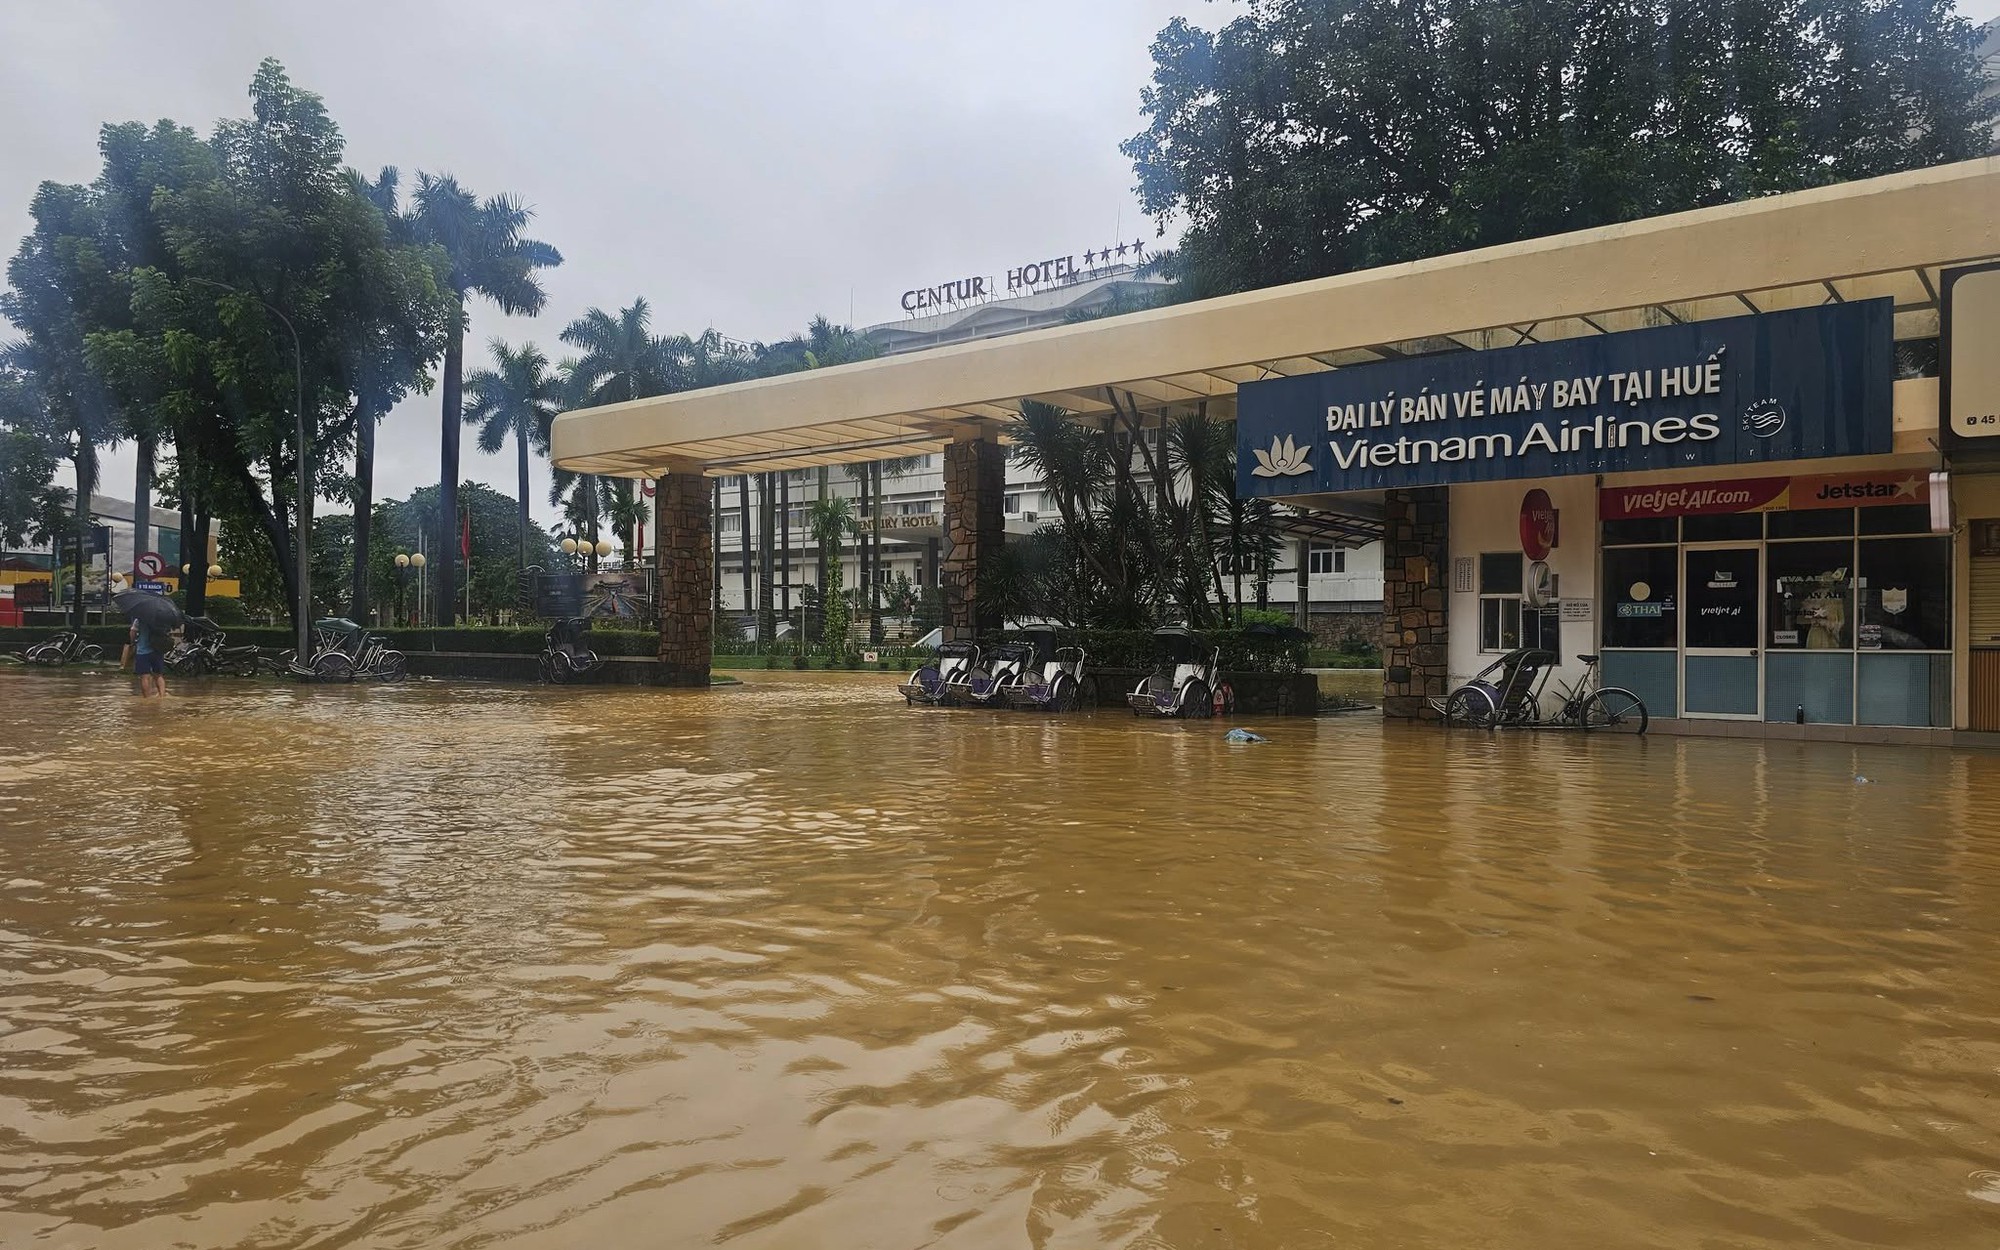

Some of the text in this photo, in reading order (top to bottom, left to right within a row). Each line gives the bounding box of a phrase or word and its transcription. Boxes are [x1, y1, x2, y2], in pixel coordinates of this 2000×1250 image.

[901, 255, 1080, 309] CENTUR HOTEL
[1326, 344, 1726, 437] ĐẠI LÝ BÁN VÉ MÁY BAY TẠI HUẾ
[1981, 415, 1996, 424] 45
[1329, 413, 1720, 470] Vietnam Airlines
[1816, 481, 1897, 500] Jetstar
[902, 515, 938, 527] HOTEL
[1633, 605, 1661, 614] THAI
